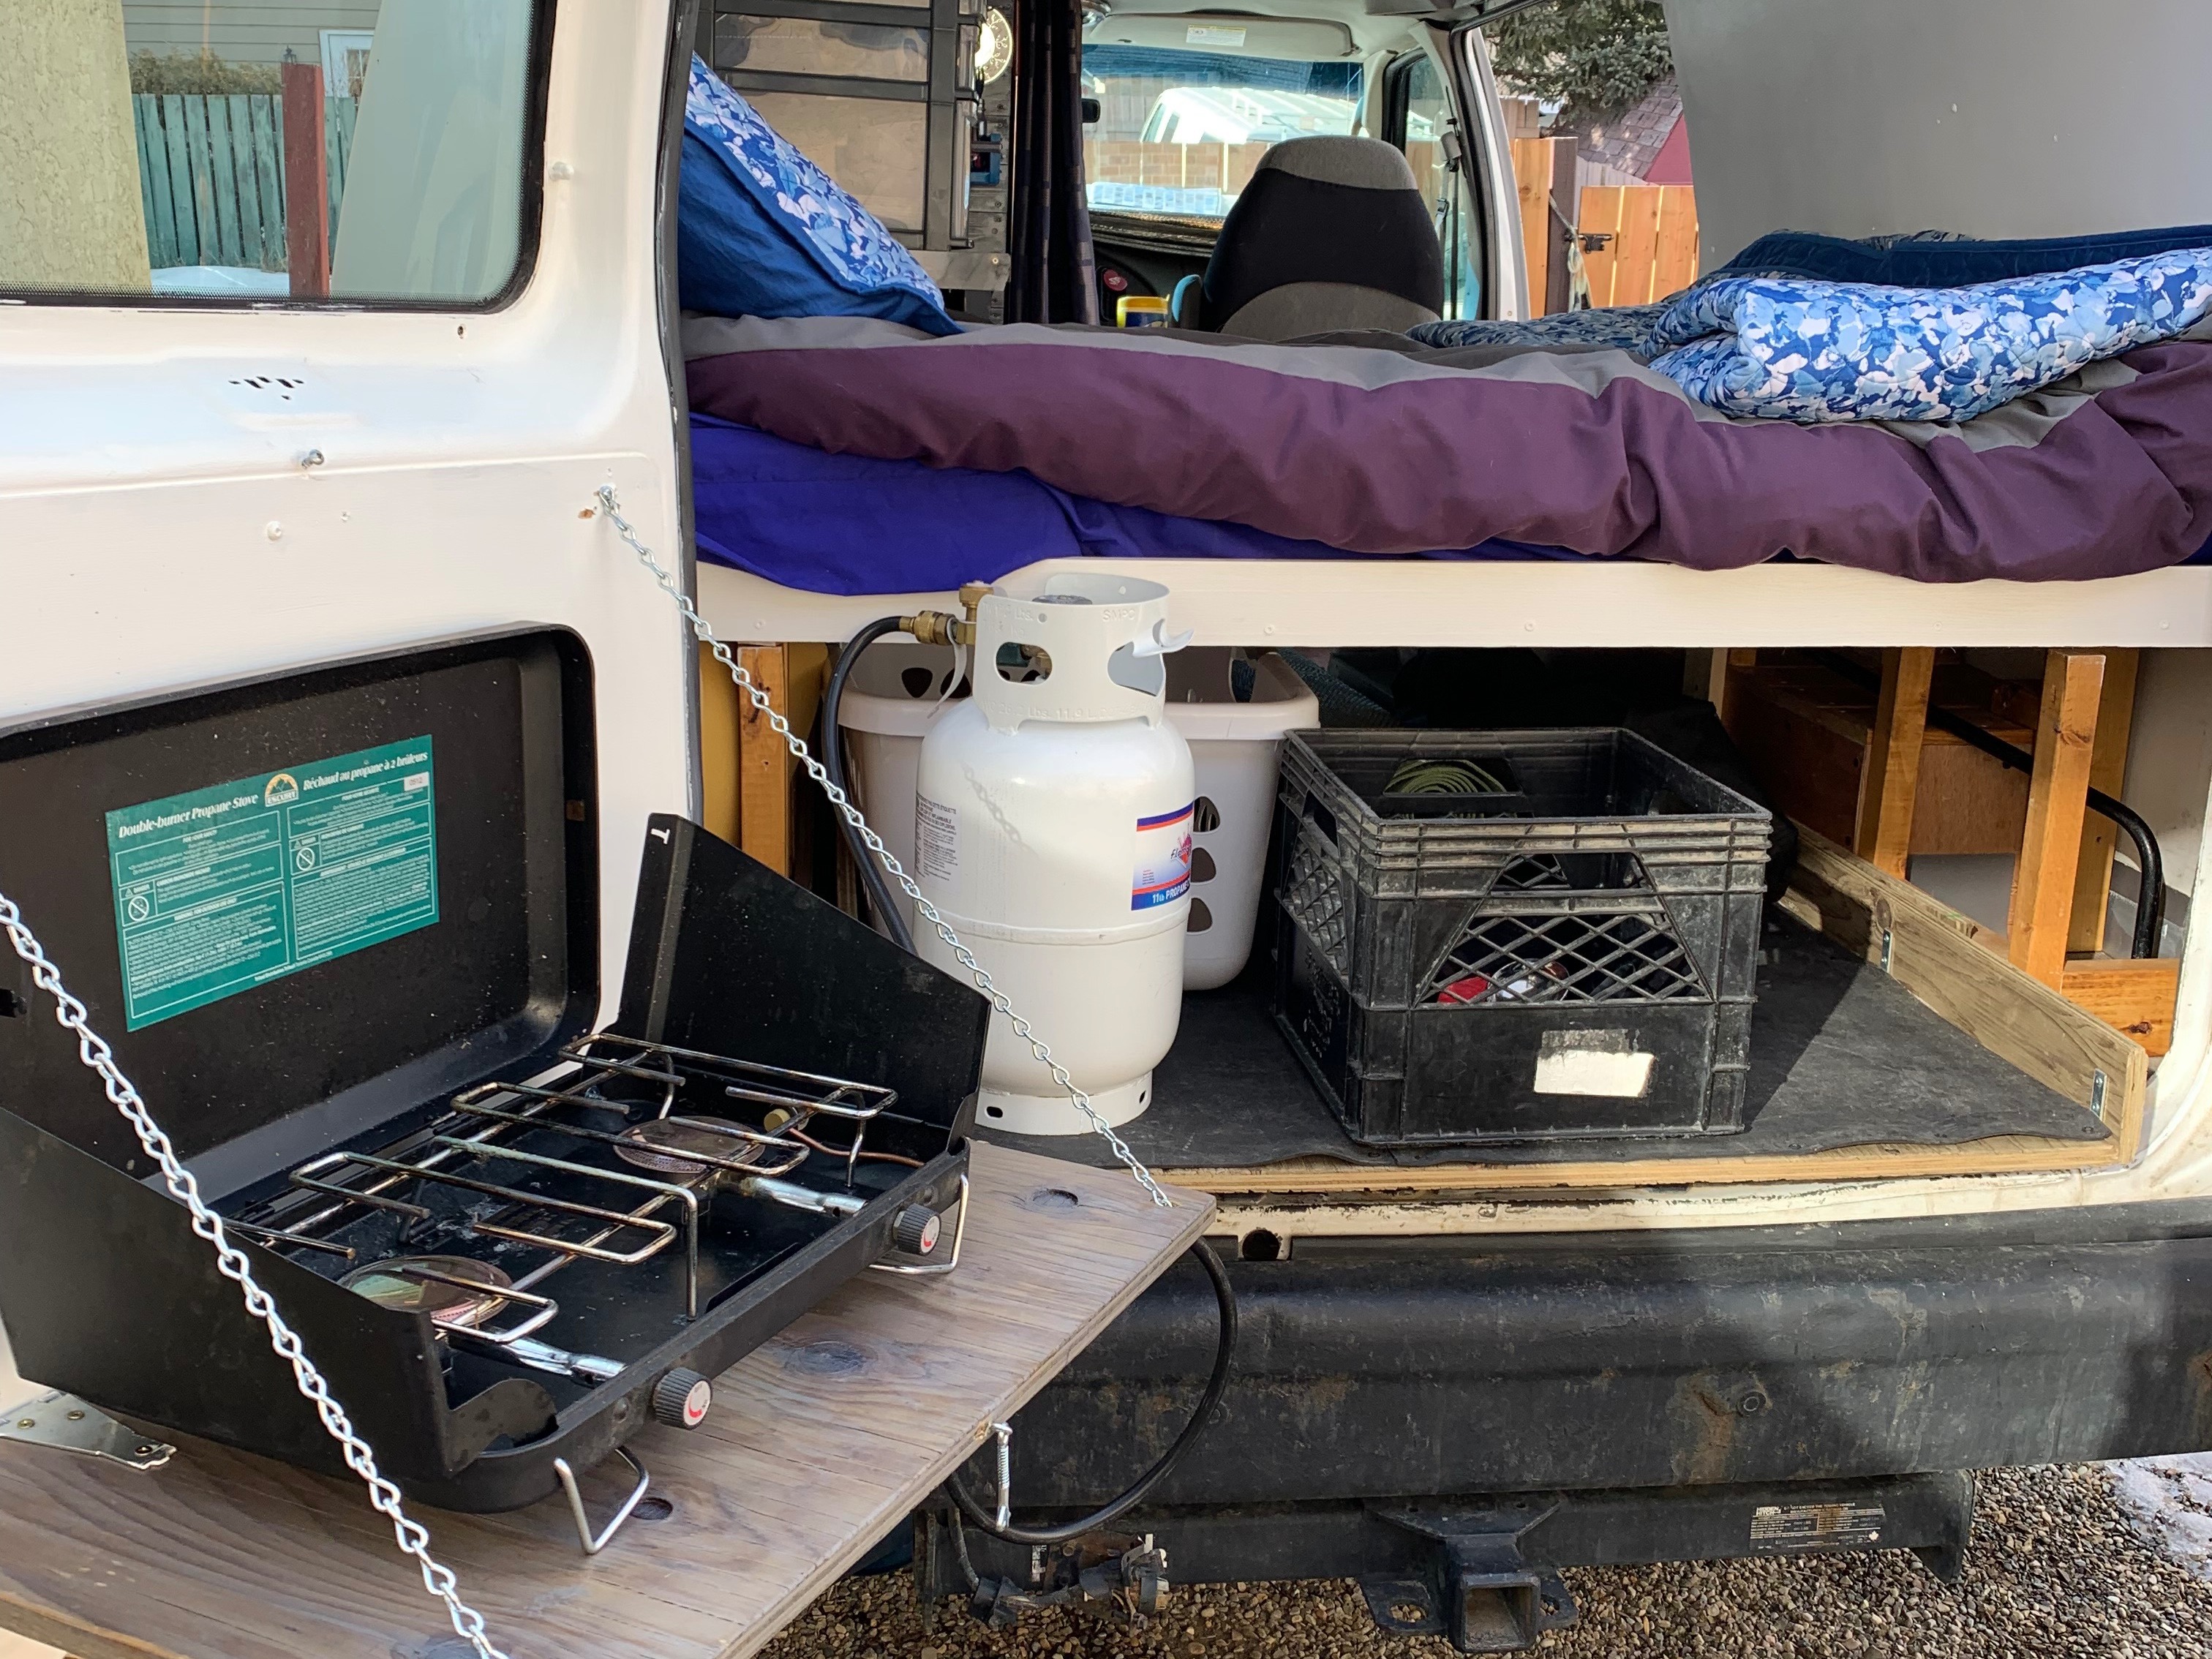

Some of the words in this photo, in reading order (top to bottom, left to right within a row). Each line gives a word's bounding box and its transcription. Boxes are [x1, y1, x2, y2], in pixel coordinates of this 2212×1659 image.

[303, 771, 339, 791] Réchaud
[339, 770, 351, 782] au
[350, 763, 384, 781] propane
[118, 811, 191, 838] Double-burner
[191, 800, 232, 820] Propane
[231, 794, 259, 809] Stove
